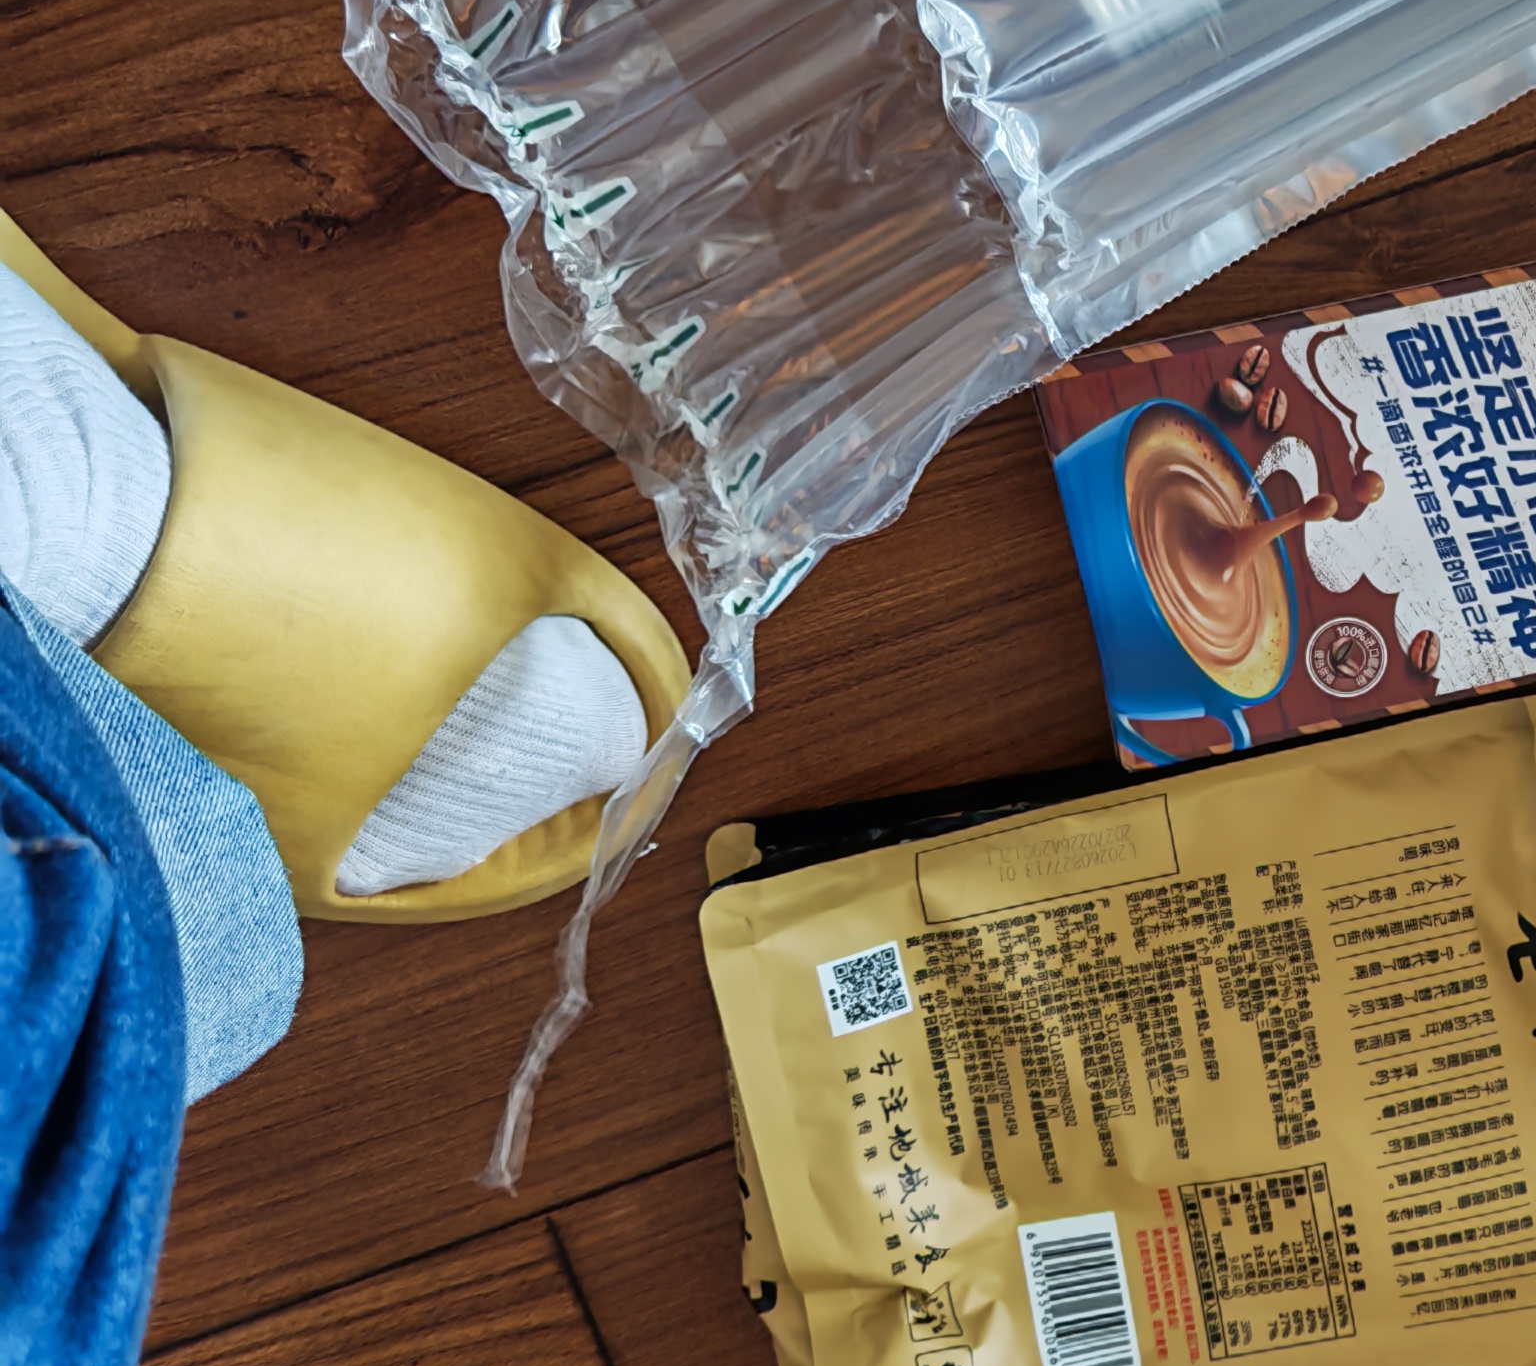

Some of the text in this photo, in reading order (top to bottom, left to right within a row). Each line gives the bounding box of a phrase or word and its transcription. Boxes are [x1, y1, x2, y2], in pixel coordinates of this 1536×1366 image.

[1357, 350, 1496, 650] #一滴香浓开启全醒的自己#
[1268, 862, 1291, 913] 产品类型:
[1282, 859, 1304, 909] 产品名称:
[1154, 885, 1187, 989] 食用方法: 去壳即食
[1194, 936, 1212, 961] 6个月
[1213, 955, 1229, 974] GB
[990, 979, 1017, 1048] 浙江省金华市
[1047, 967, 1074, 1038] 浙江省金华市
[1217, 973, 1235, 1004] 19300
[933, 987, 961, 1061] 400-155-3577
[843, 1065, 879, 1162] 美味传承
[868, 1046, 953, 1274] 专注地域美食
[1029, 1249, 1050, 1307] 930755
[1266, 1320, 1279, 1341] 7%
[1303, 1307, 1317, 1334] 40%
